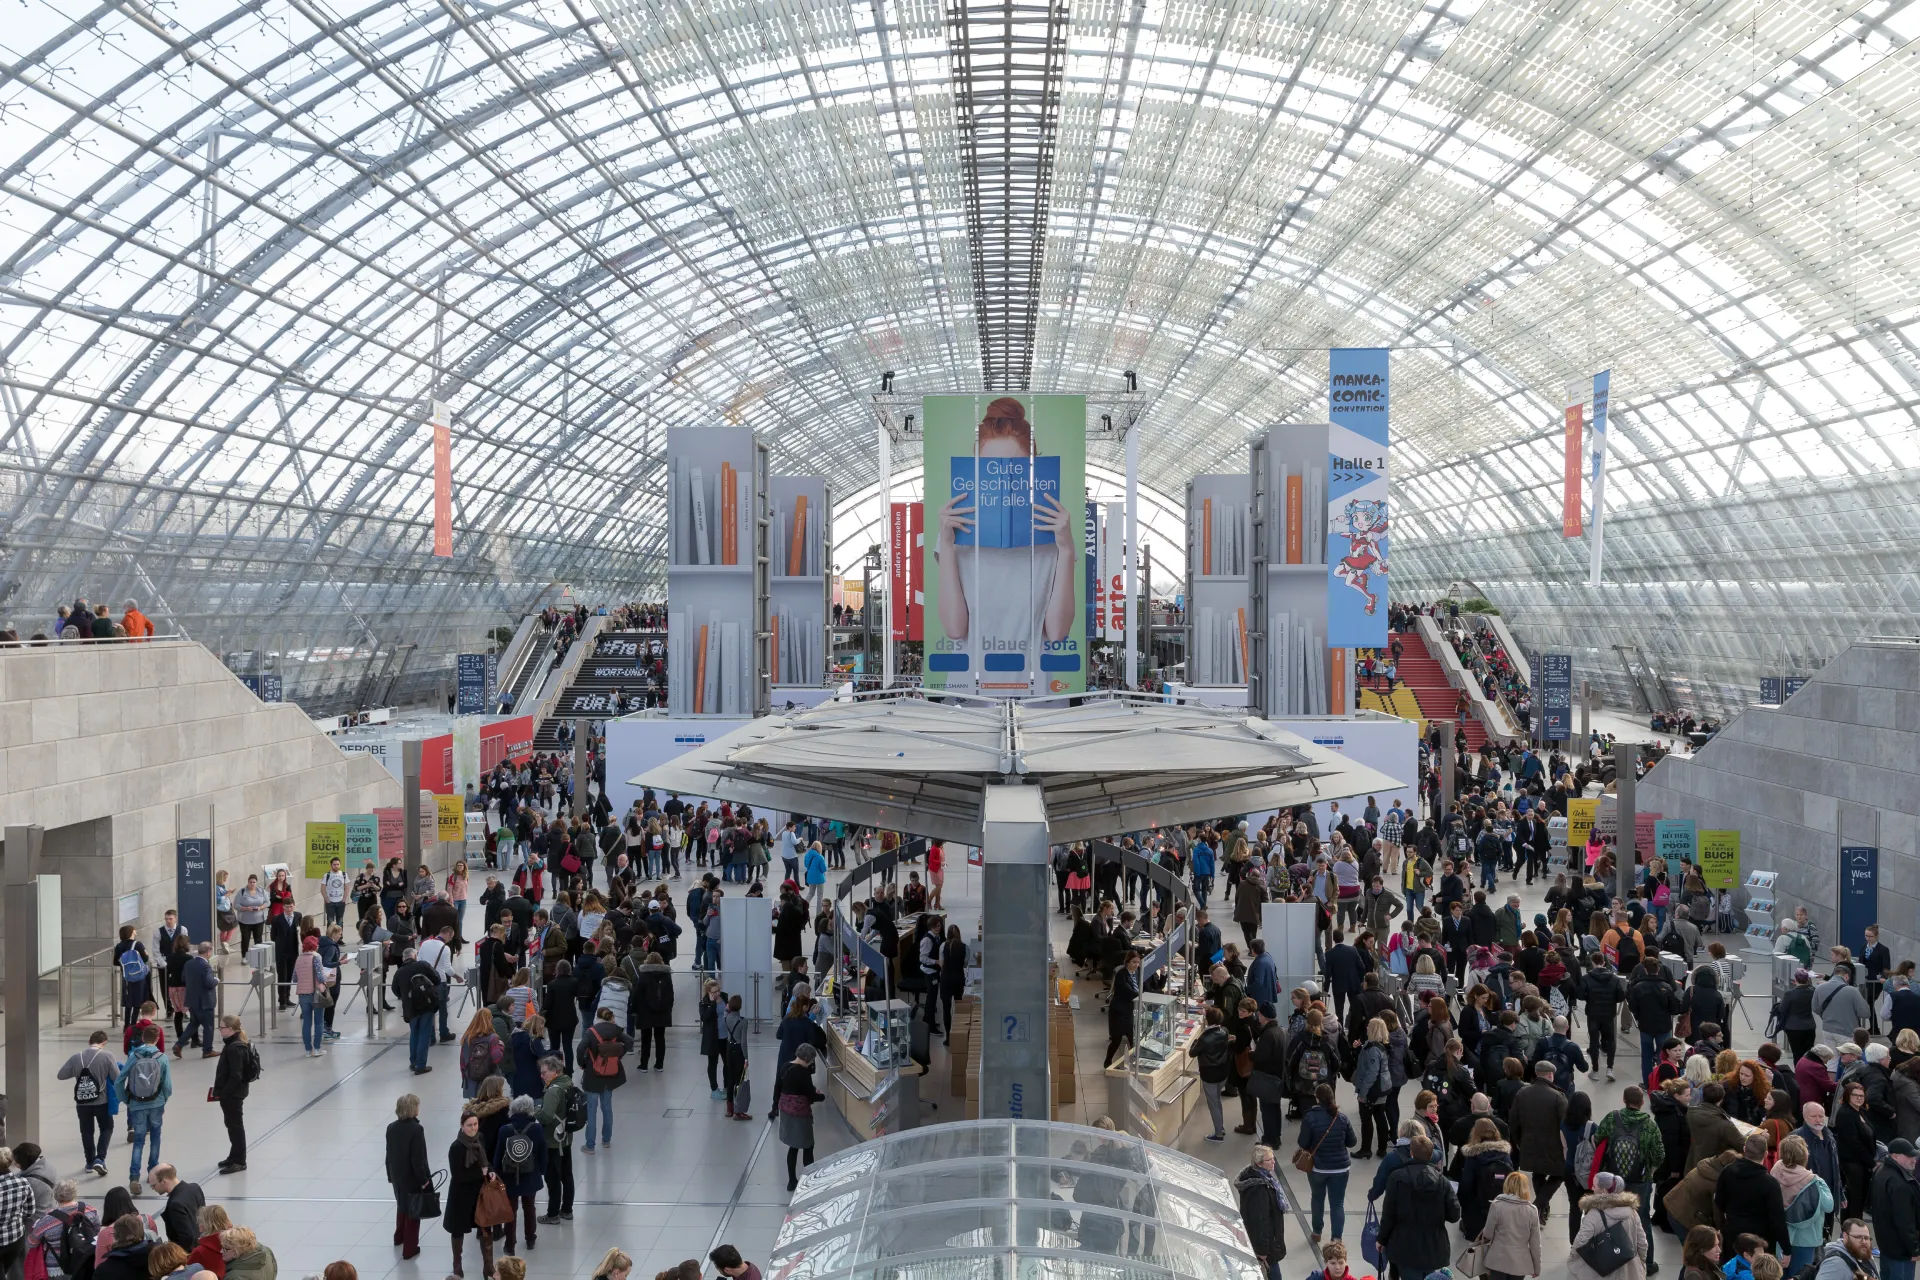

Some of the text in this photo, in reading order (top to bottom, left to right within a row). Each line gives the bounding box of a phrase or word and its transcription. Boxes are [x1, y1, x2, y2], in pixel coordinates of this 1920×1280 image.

[1332, 374, 1385, 386] MANGA-
[986, 461, 1023, 475] Gute
[1333, 457, 1385, 470] Halle 1
[952, 476, 1056, 491] Geschichten
[980, 493, 1029, 506] für alle.
[1110, 574, 1124, 631] arte
[936, 636, 1078, 651] das blaue sofa
[572, 693, 606, 710] FÜR
[438, 817, 459, 825] ZEIT
[1704, 851, 1734, 859] BUCH
[185, 861, 205, 869] West
[185, 869, 191, 877] 2
[1851, 870, 1872, 878] West
[1851, 878, 1855, 886] 1
[77, 1093, 99, 1101] EGAL
